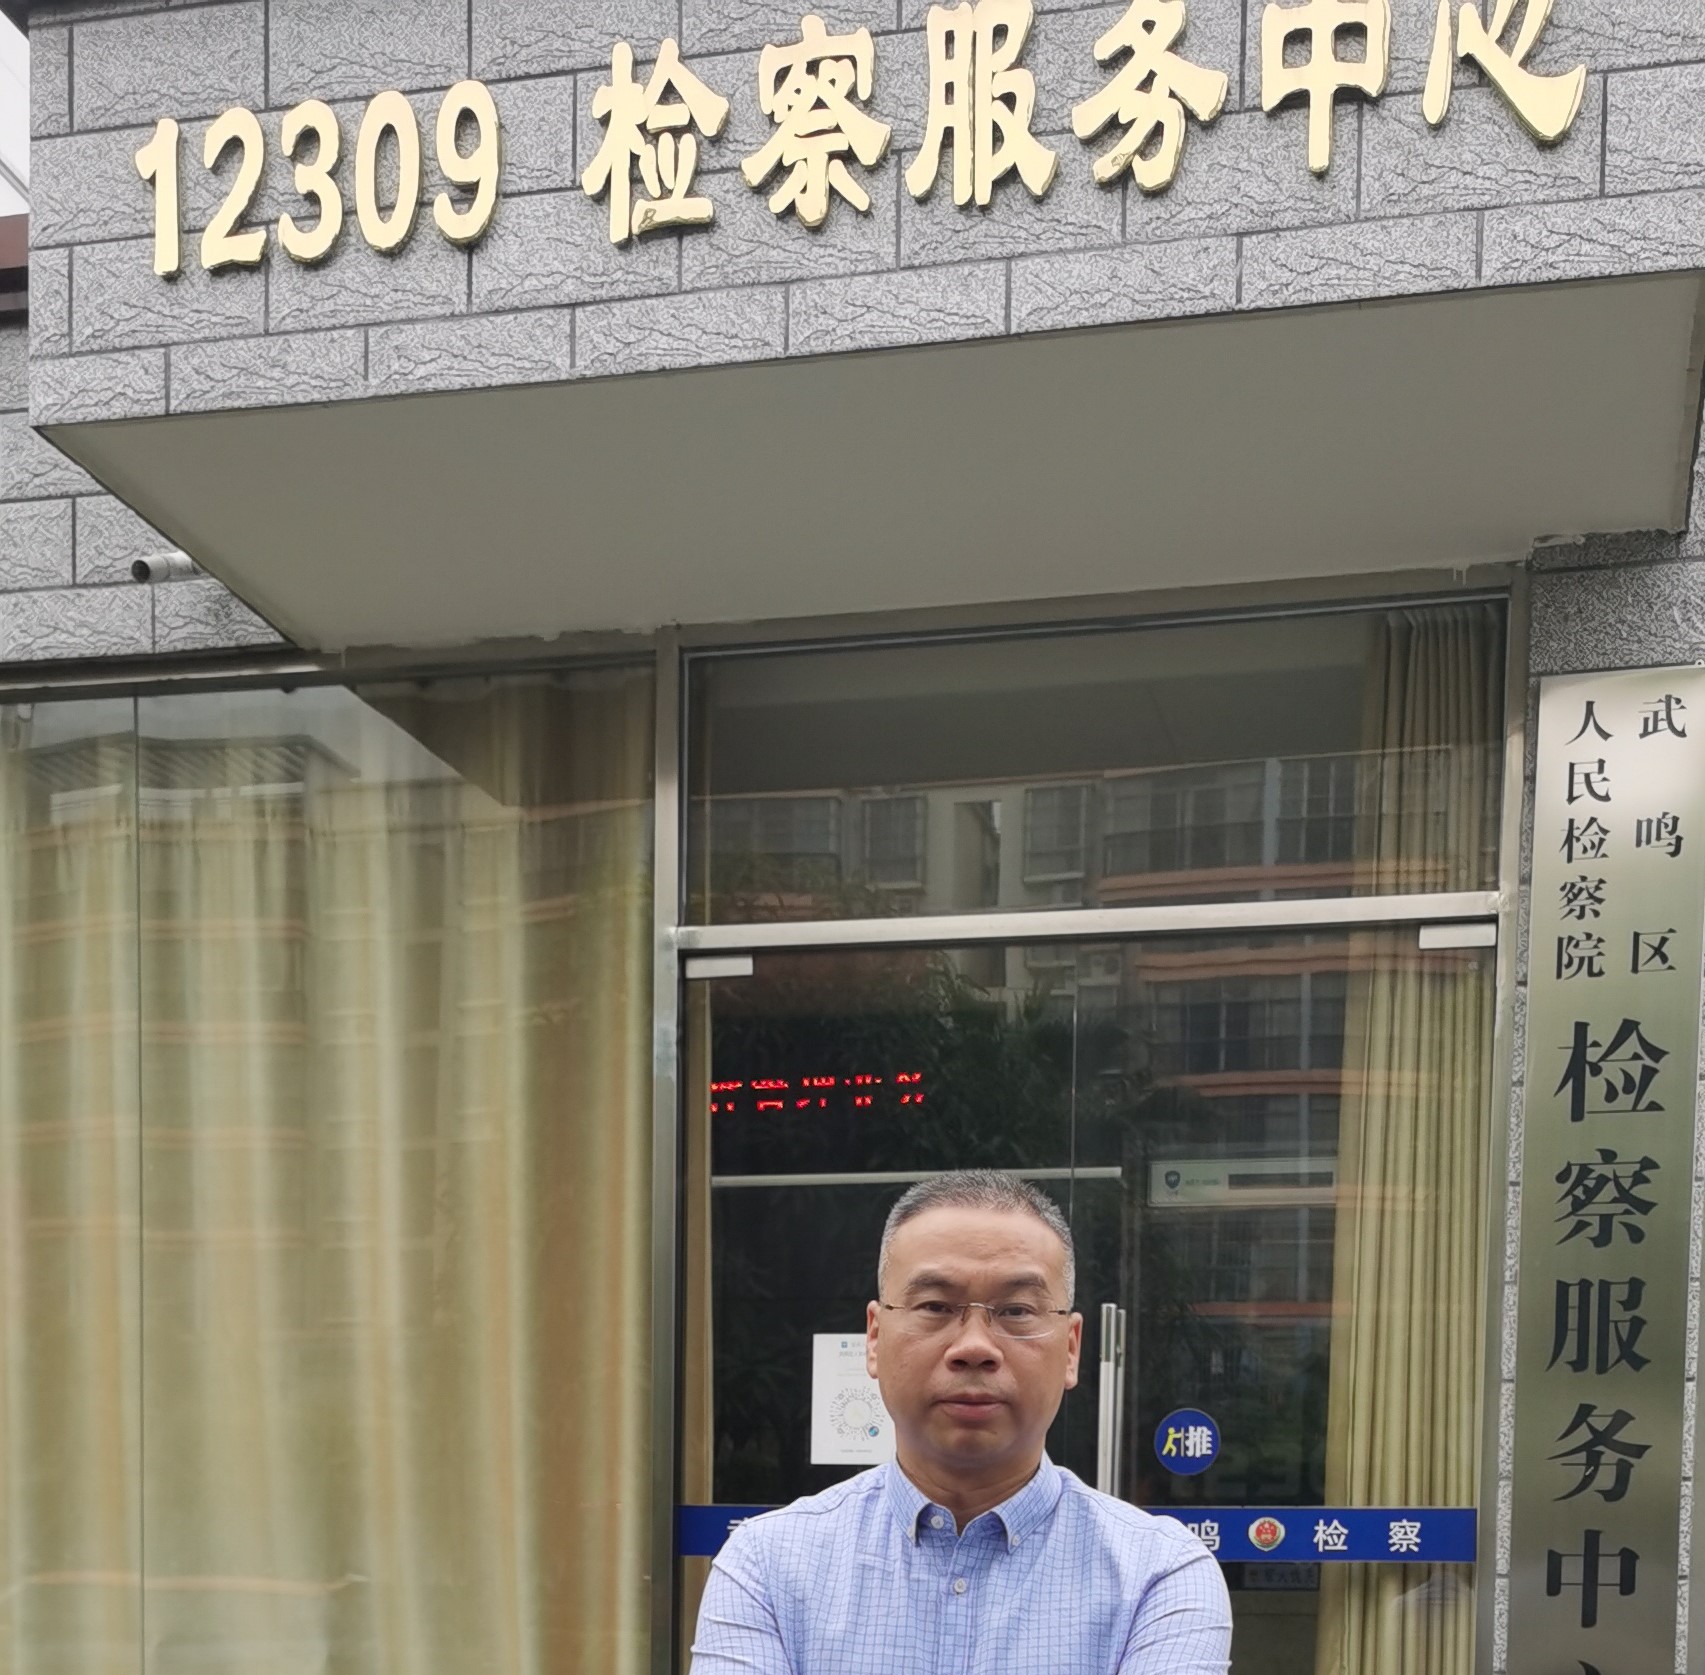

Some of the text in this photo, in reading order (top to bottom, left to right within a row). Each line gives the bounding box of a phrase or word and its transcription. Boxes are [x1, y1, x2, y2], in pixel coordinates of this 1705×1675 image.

[134, 0, 1587, 277] 12309 检察服务中心
[1556, 700, 1614, 980] 人民检察院
[1631, 694, 1687, 975] 武鸣区
[1185, 1425, 1213, 1458] 推
[1313, 1518, 1422, 1553] 检察
